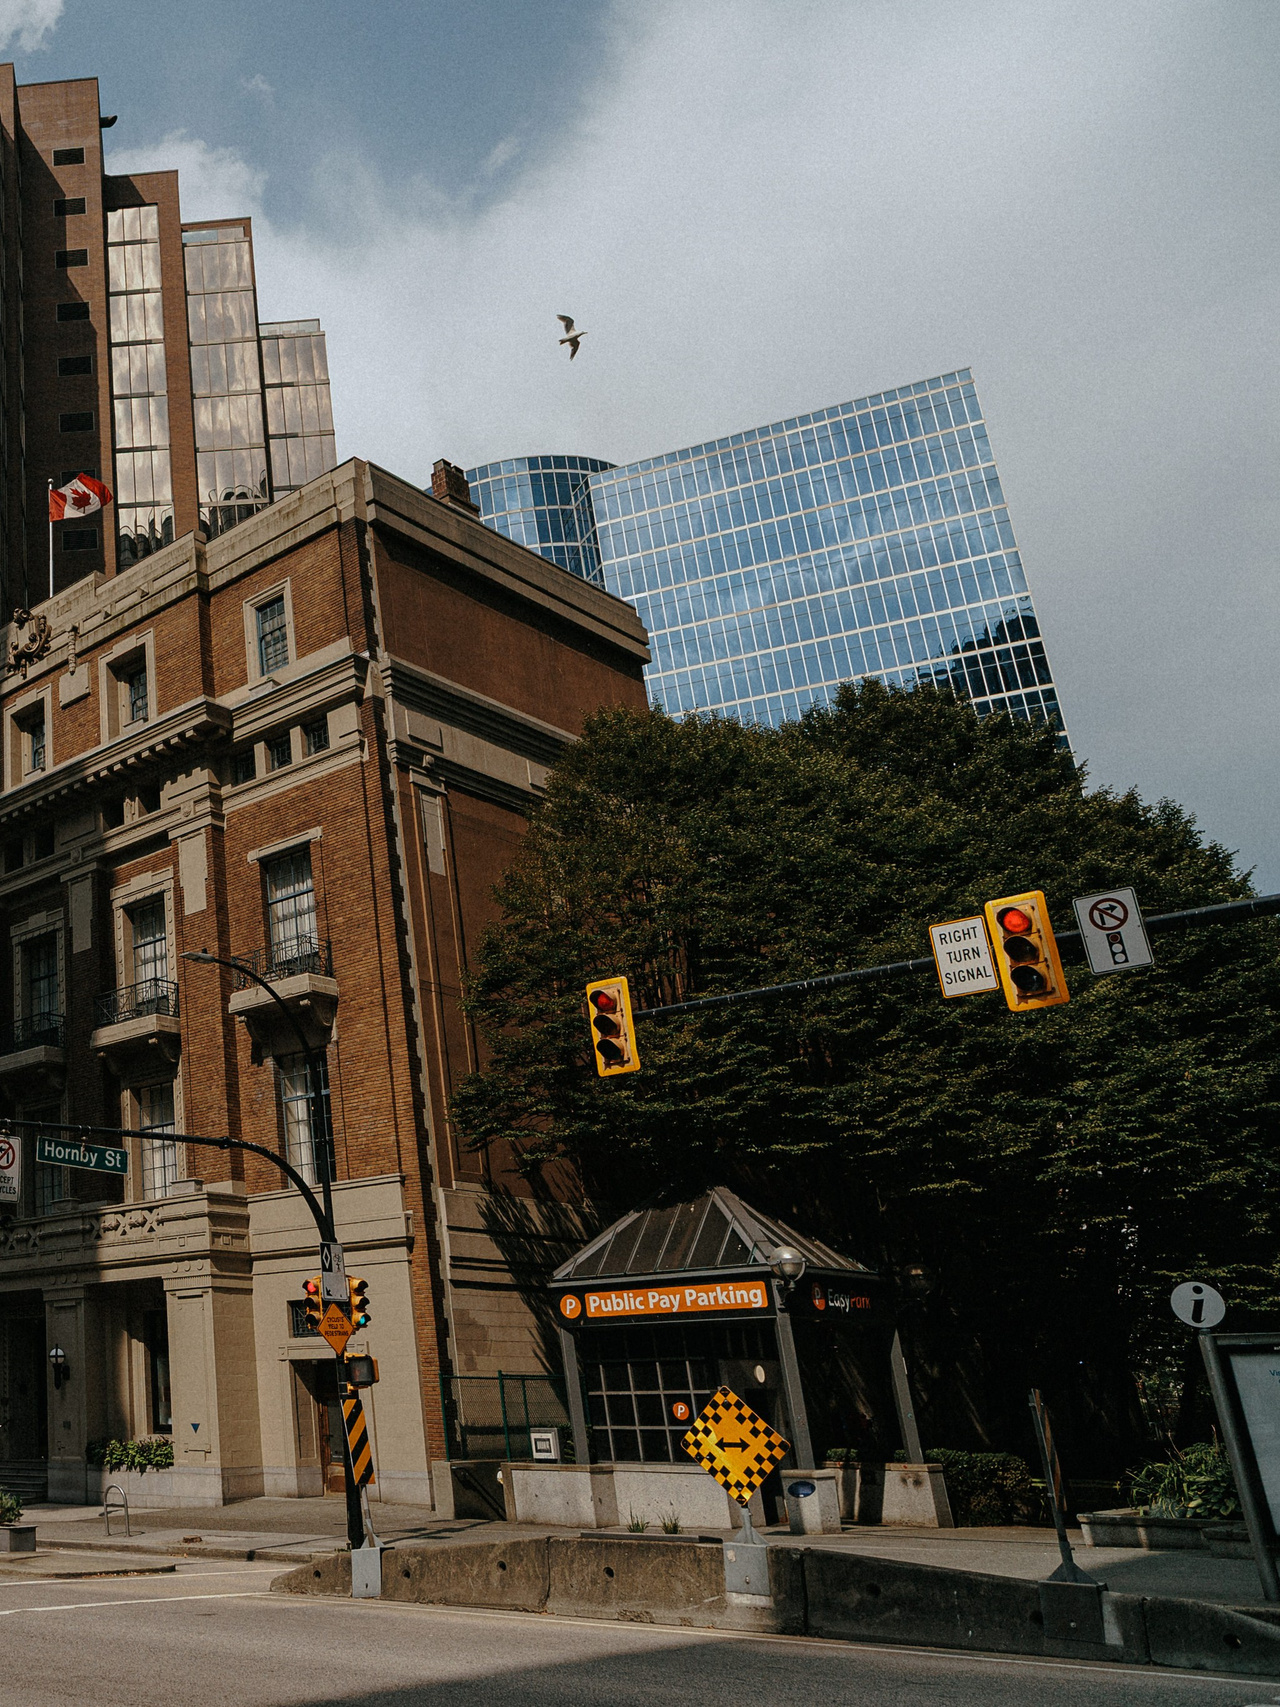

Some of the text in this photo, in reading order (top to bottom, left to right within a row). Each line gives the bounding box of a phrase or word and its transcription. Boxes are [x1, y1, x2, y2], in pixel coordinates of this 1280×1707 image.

[939, 926, 977, 945] RIGHT
[946, 946, 981, 964] TURN
[945, 966, 992, 985] SIGNAL
[44, 1140, 122, 1168] Hornby St
[565, 1285, 763, 1315] P Public Pay Parking
